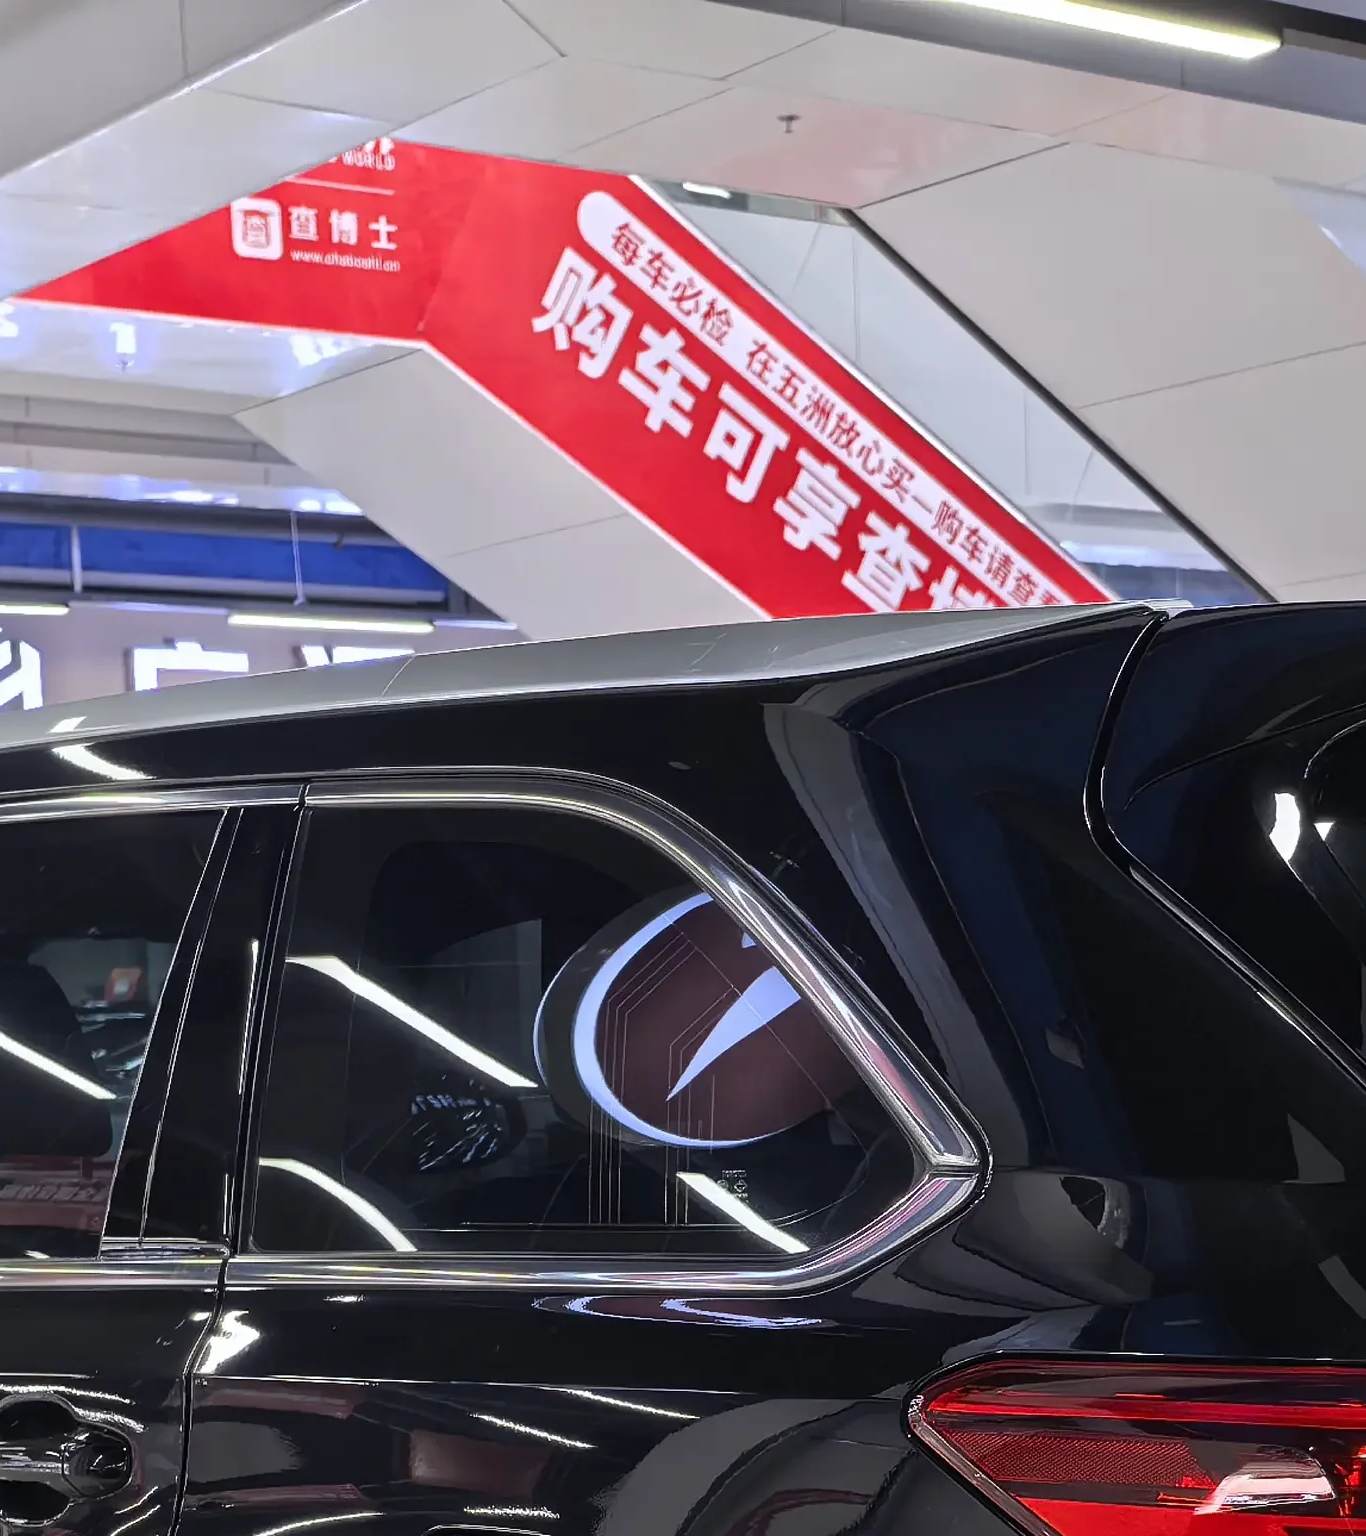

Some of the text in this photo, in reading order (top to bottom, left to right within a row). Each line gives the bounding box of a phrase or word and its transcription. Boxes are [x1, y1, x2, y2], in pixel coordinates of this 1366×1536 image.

[288, 204, 398, 251] 查博士
[610, 221, 734, 347] 每车必检
